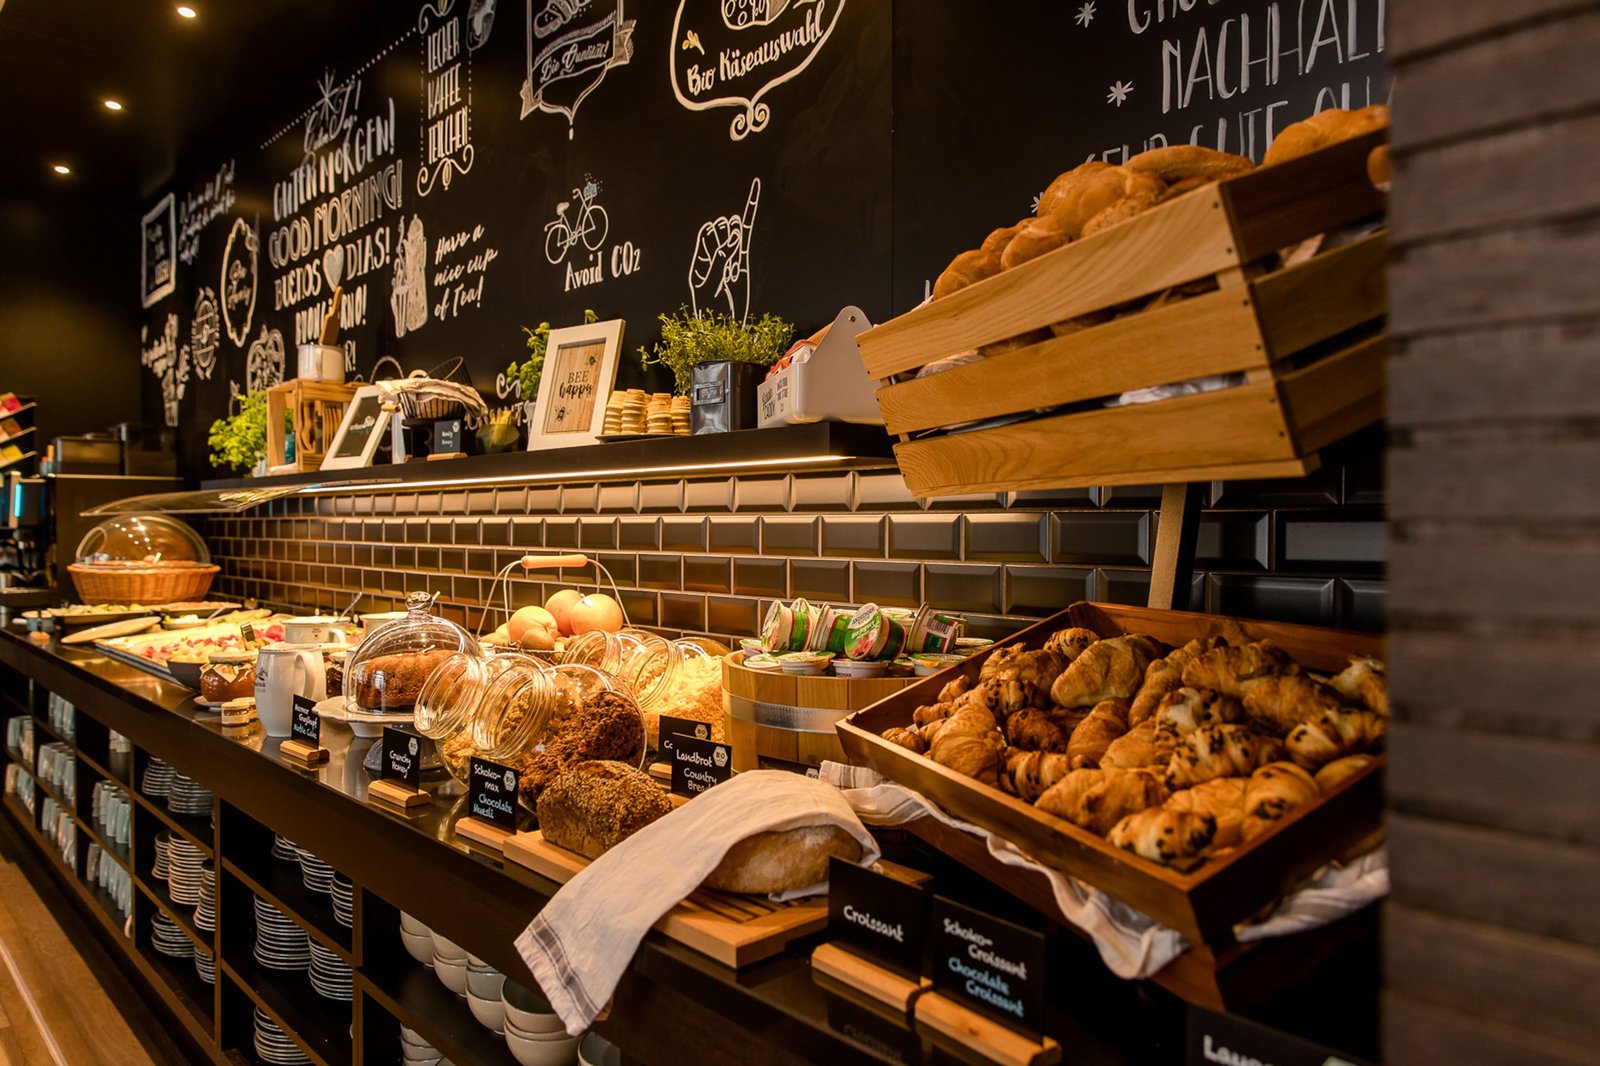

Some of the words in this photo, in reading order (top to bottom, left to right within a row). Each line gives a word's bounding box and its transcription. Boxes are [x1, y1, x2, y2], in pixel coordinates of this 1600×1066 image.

[687, 64, 716, 96] Bio
[719, 0, 825, 82] Käseauswahl
[427, 62, 462, 120] KAFFEE
[427, 105, 468, 165] TEILCHEN
[273, 163, 318, 222] GUTEN
[319, 97, 395, 194] MORGEN!
[268, 216, 312, 270] GOOD
[313, 159, 403, 251] MORNING!
[345, 226, 391, 281] DIAS!
[435, 231, 471, 265] Have
[472, 224, 485, 242] a
[434, 264, 465, 287] nice
[467, 247, 499, 274] cup
[564, 250, 604, 292] Avoid
[611, 241, 641, 278] CO2
[434, 287, 450, 321] of
[453, 275, 484, 317] Tea!
[559, 382, 593, 400] happy
[567, 370, 590, 384] BEE
[474, 763, 502, 780] Schoko-
[675, 749, 713, 768] Landbrot
[683, 767, 717, 785] Country
[472, 803, 495, 819] Muesli
[478, 793, 513, 814] Chocolate
[843, 904, 904, 943] Croissant
[943, 917, 994, 947] Schoko-
[947, 957, 1010, 996] Chocolate
[967, 943, 1027, 981] Croissant
[964, 979, 1025, 1018] Croissant
